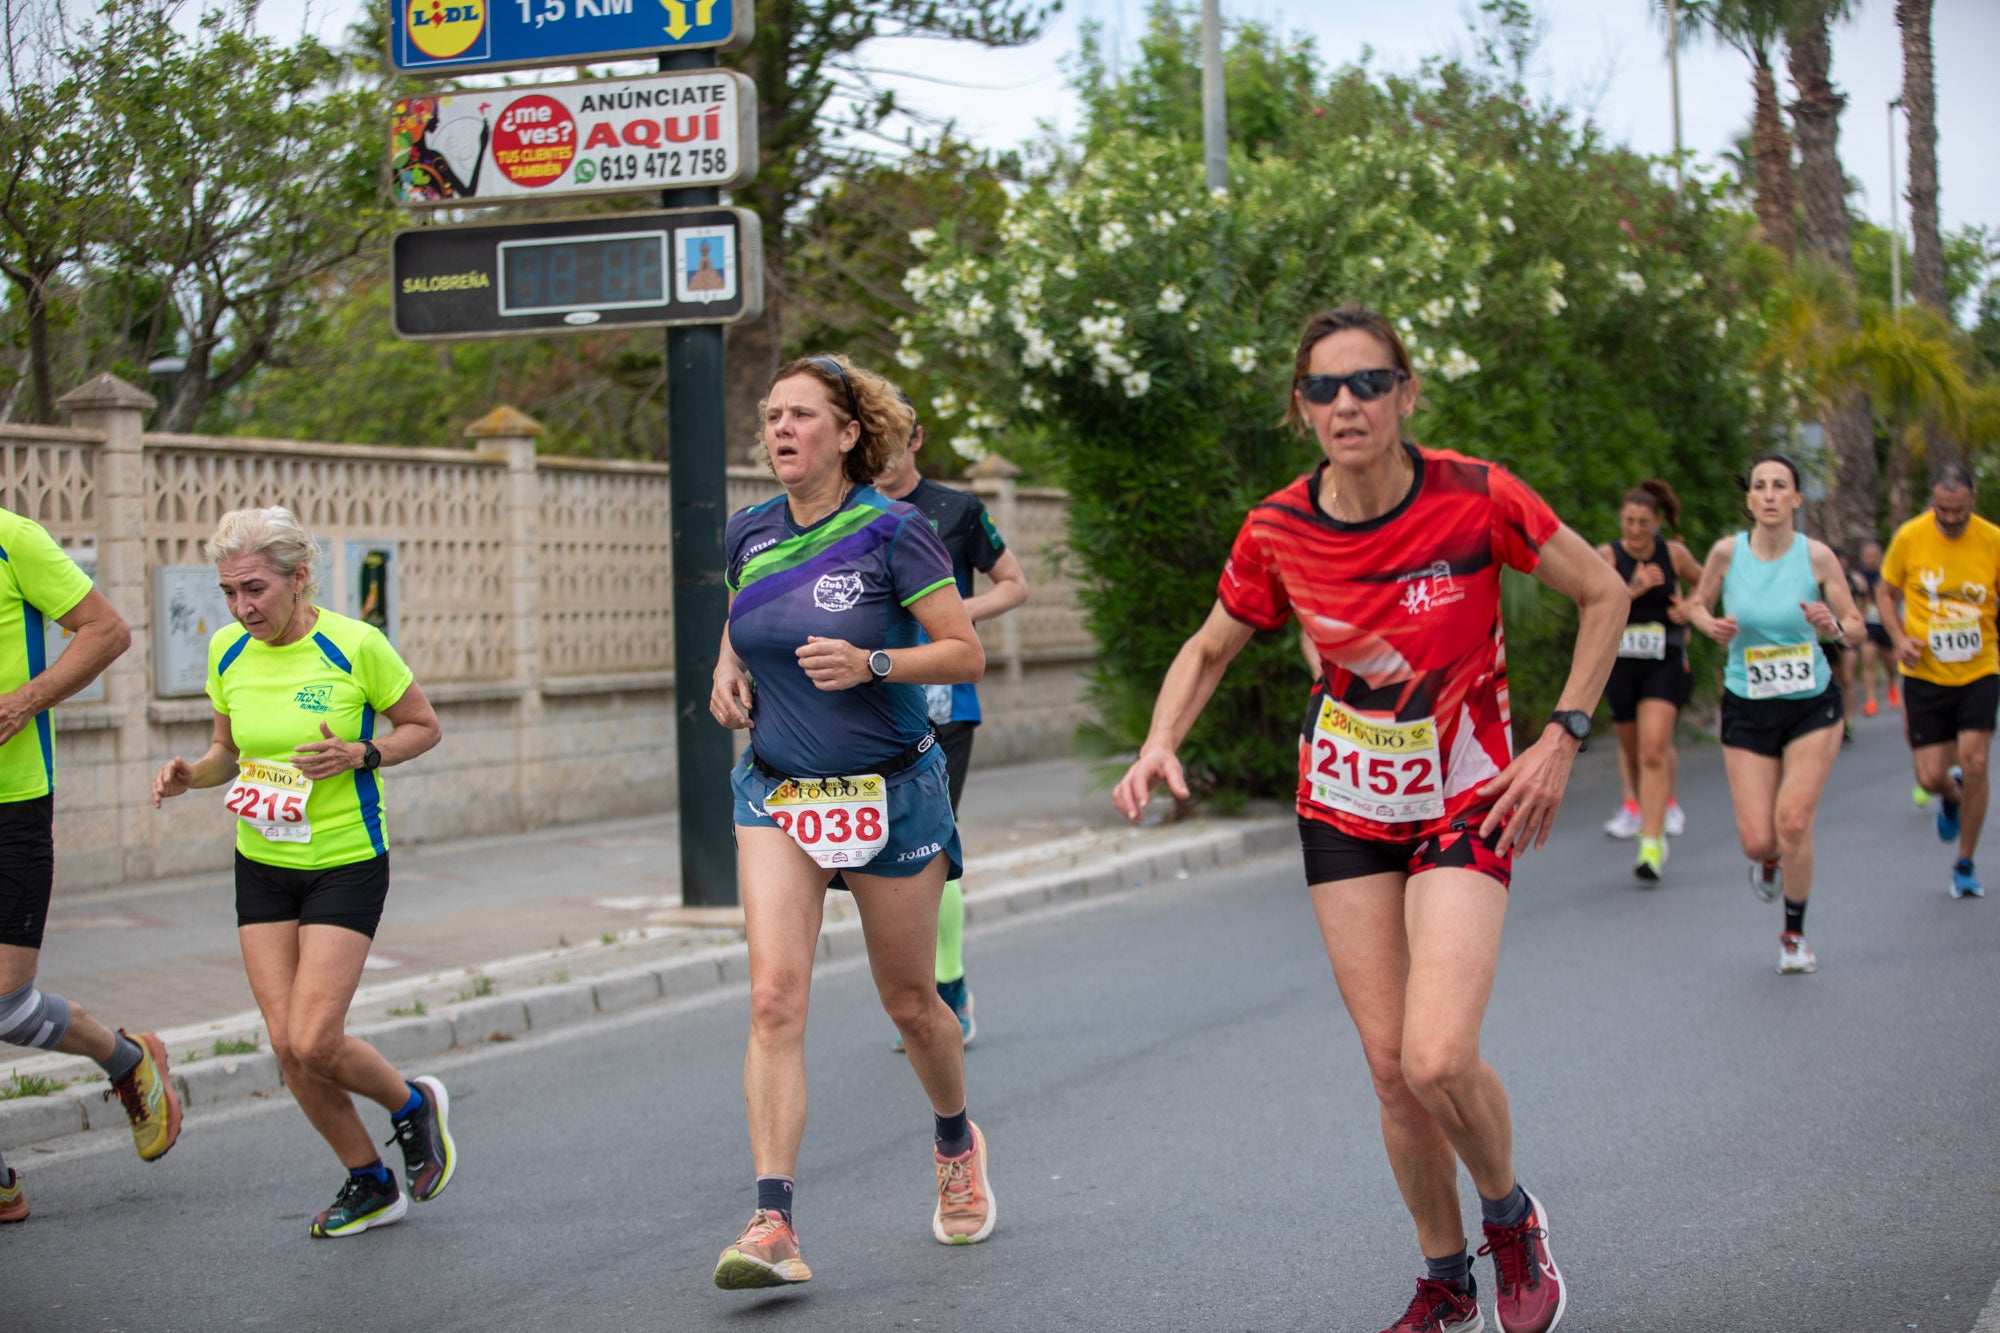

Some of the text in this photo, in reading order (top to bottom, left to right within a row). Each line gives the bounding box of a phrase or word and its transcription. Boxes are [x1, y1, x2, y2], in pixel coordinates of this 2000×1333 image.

[575, 0, 633, 18] KM
[579, 84, 727, 113] ANÚNCIATE
[501, 105, 552, 132] ¿me
[583, 105, 722, 149] AQUÍ
[518, 120, 573, 146] ves?
[520, 145, 573, 163] CLIENTES
[601, 147, 728, 182] 619 472 758
[402, 269, 490, 293] SALOBREÑA
[820, 580, 842, 589] Club
[1932, 632, 1980, 651] 3100
[1749, 661, 1810, 685] 3333
[1317, 738, 1435, 796] 2152
[780, 784, 798, 799] 38
[226, 787, 303, 823] 2215
